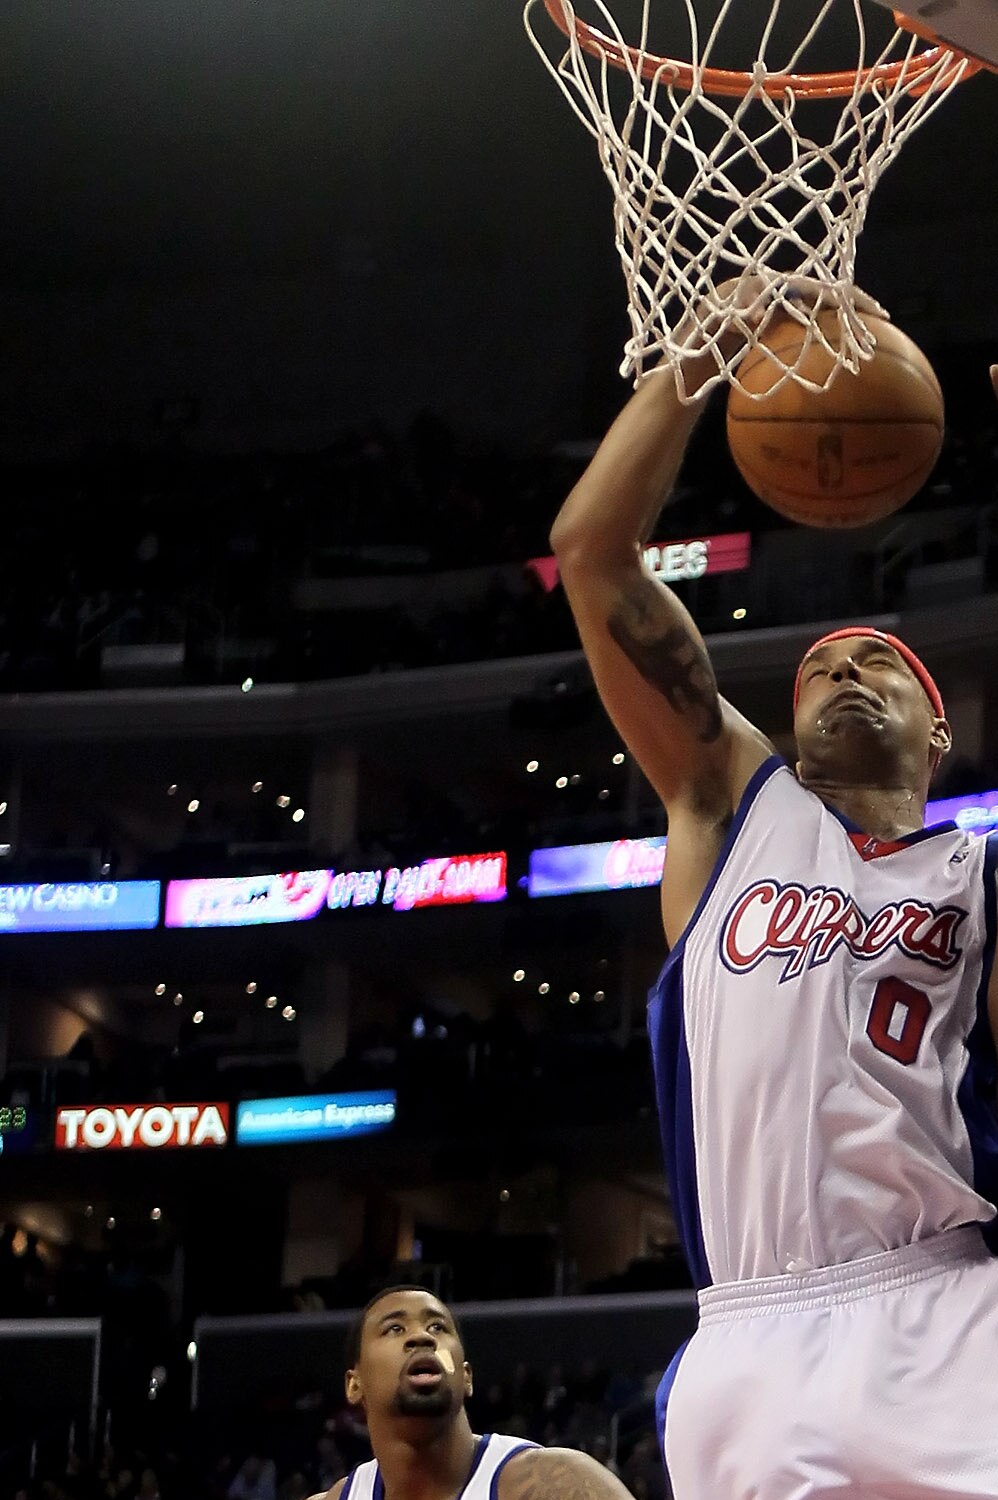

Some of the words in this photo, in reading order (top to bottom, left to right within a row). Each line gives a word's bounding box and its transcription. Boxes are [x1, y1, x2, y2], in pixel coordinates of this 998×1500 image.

[643, 540, 709, 582] LES
[719, 880, 968, 984] Clippers
[865, 975, 932, 1066] 0
[58, 1105, 228, 1149] TOYOTA
